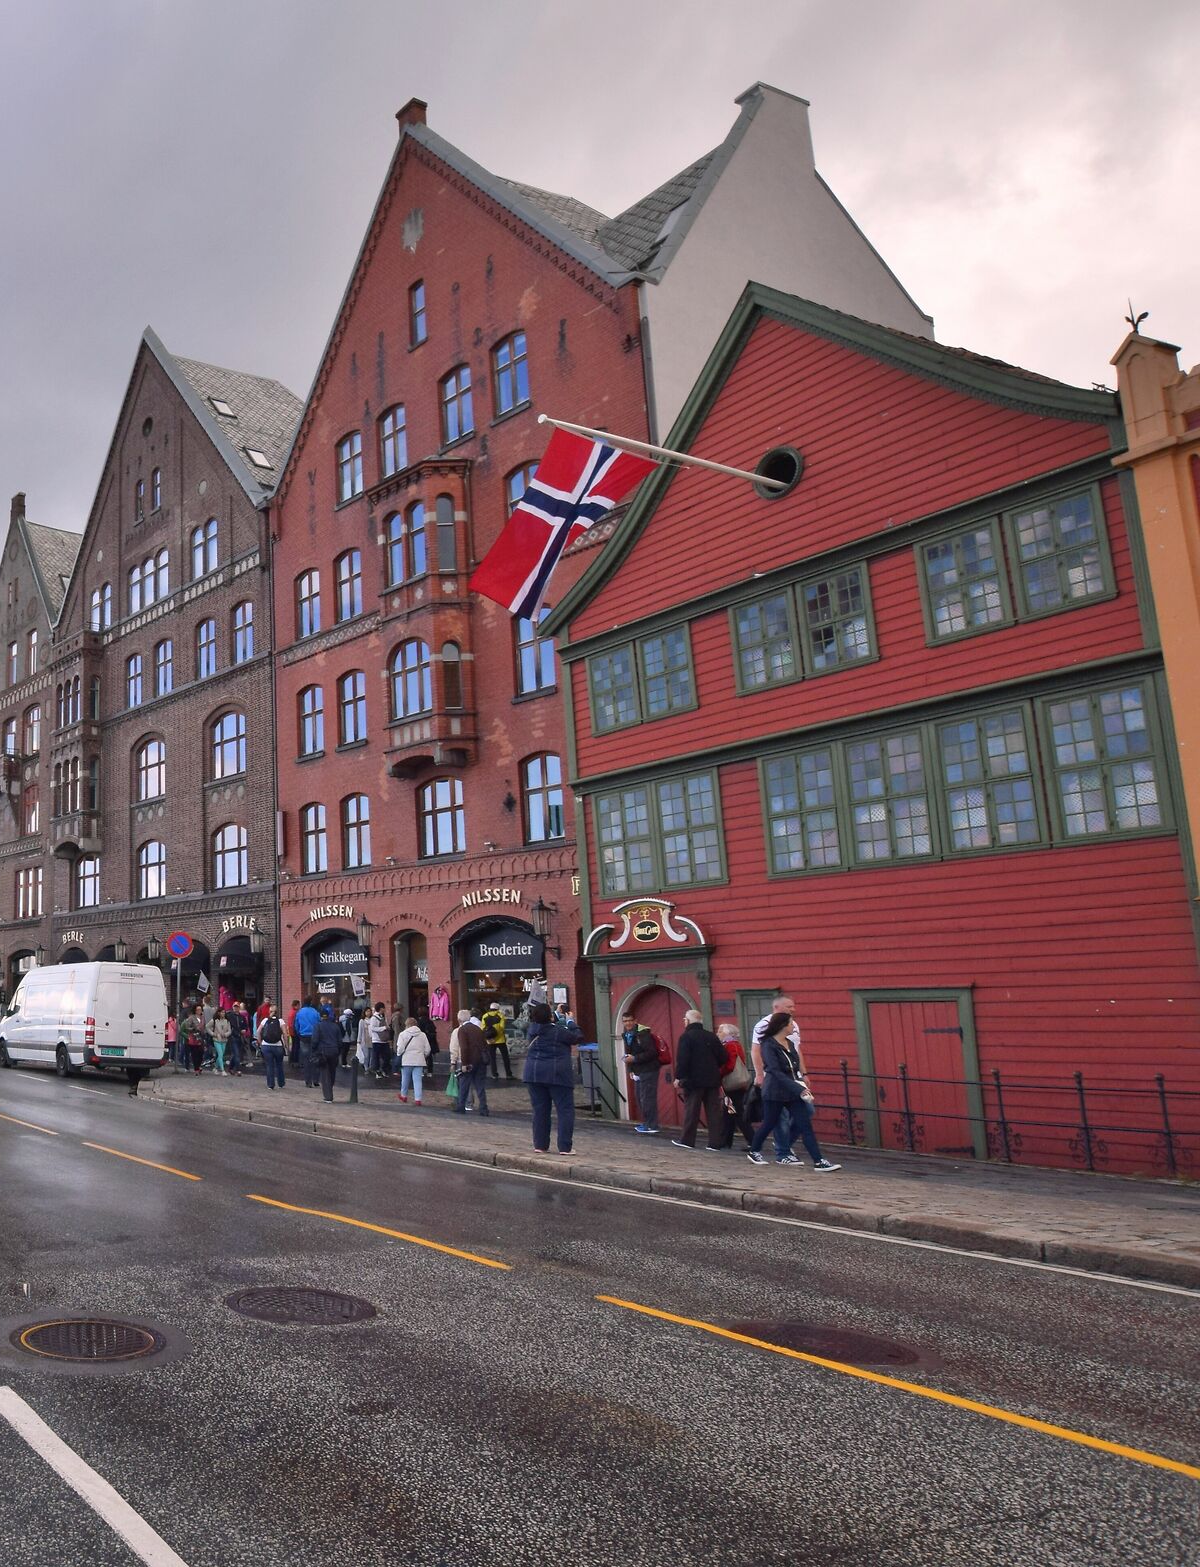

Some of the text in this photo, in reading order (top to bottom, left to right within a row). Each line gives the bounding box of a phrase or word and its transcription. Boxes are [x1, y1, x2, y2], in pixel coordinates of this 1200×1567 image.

[461, 888, 520, 908] NILSSEN
[310, 904, 353, 922] NILSSEN
[222, 915, 256, 933] BERLE
[62, 930, 85, 944] BERLE
[479, 942, 533, 957] Broderier
[320, 951, 368, 965] Strikkegan.
